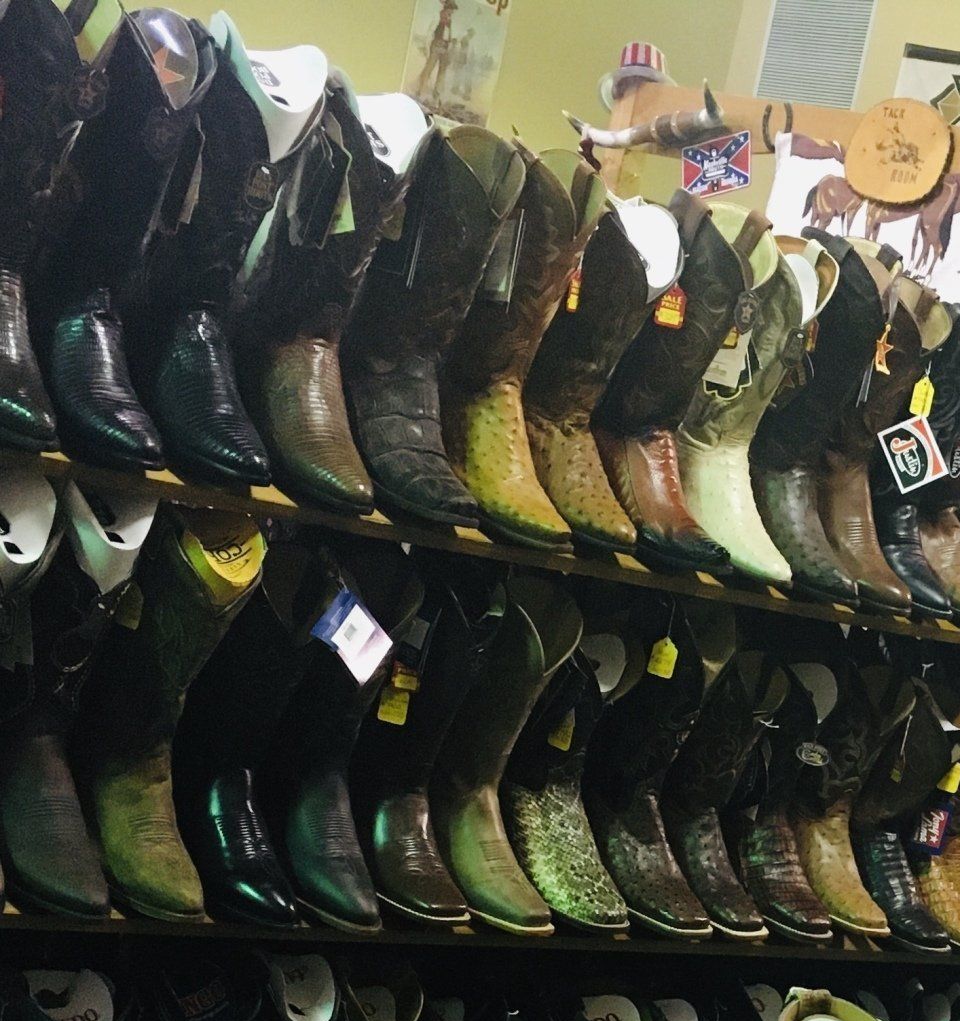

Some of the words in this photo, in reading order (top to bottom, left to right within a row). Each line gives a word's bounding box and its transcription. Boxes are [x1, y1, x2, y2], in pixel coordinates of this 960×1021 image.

[883, 106, 905, 119] TACK
[890, 169, 919, 184] ROOM
[661, 300, 681, 310] PRICE
[662, 294, 682, 305] SALE
[890, 436, 922, 477] Justin
